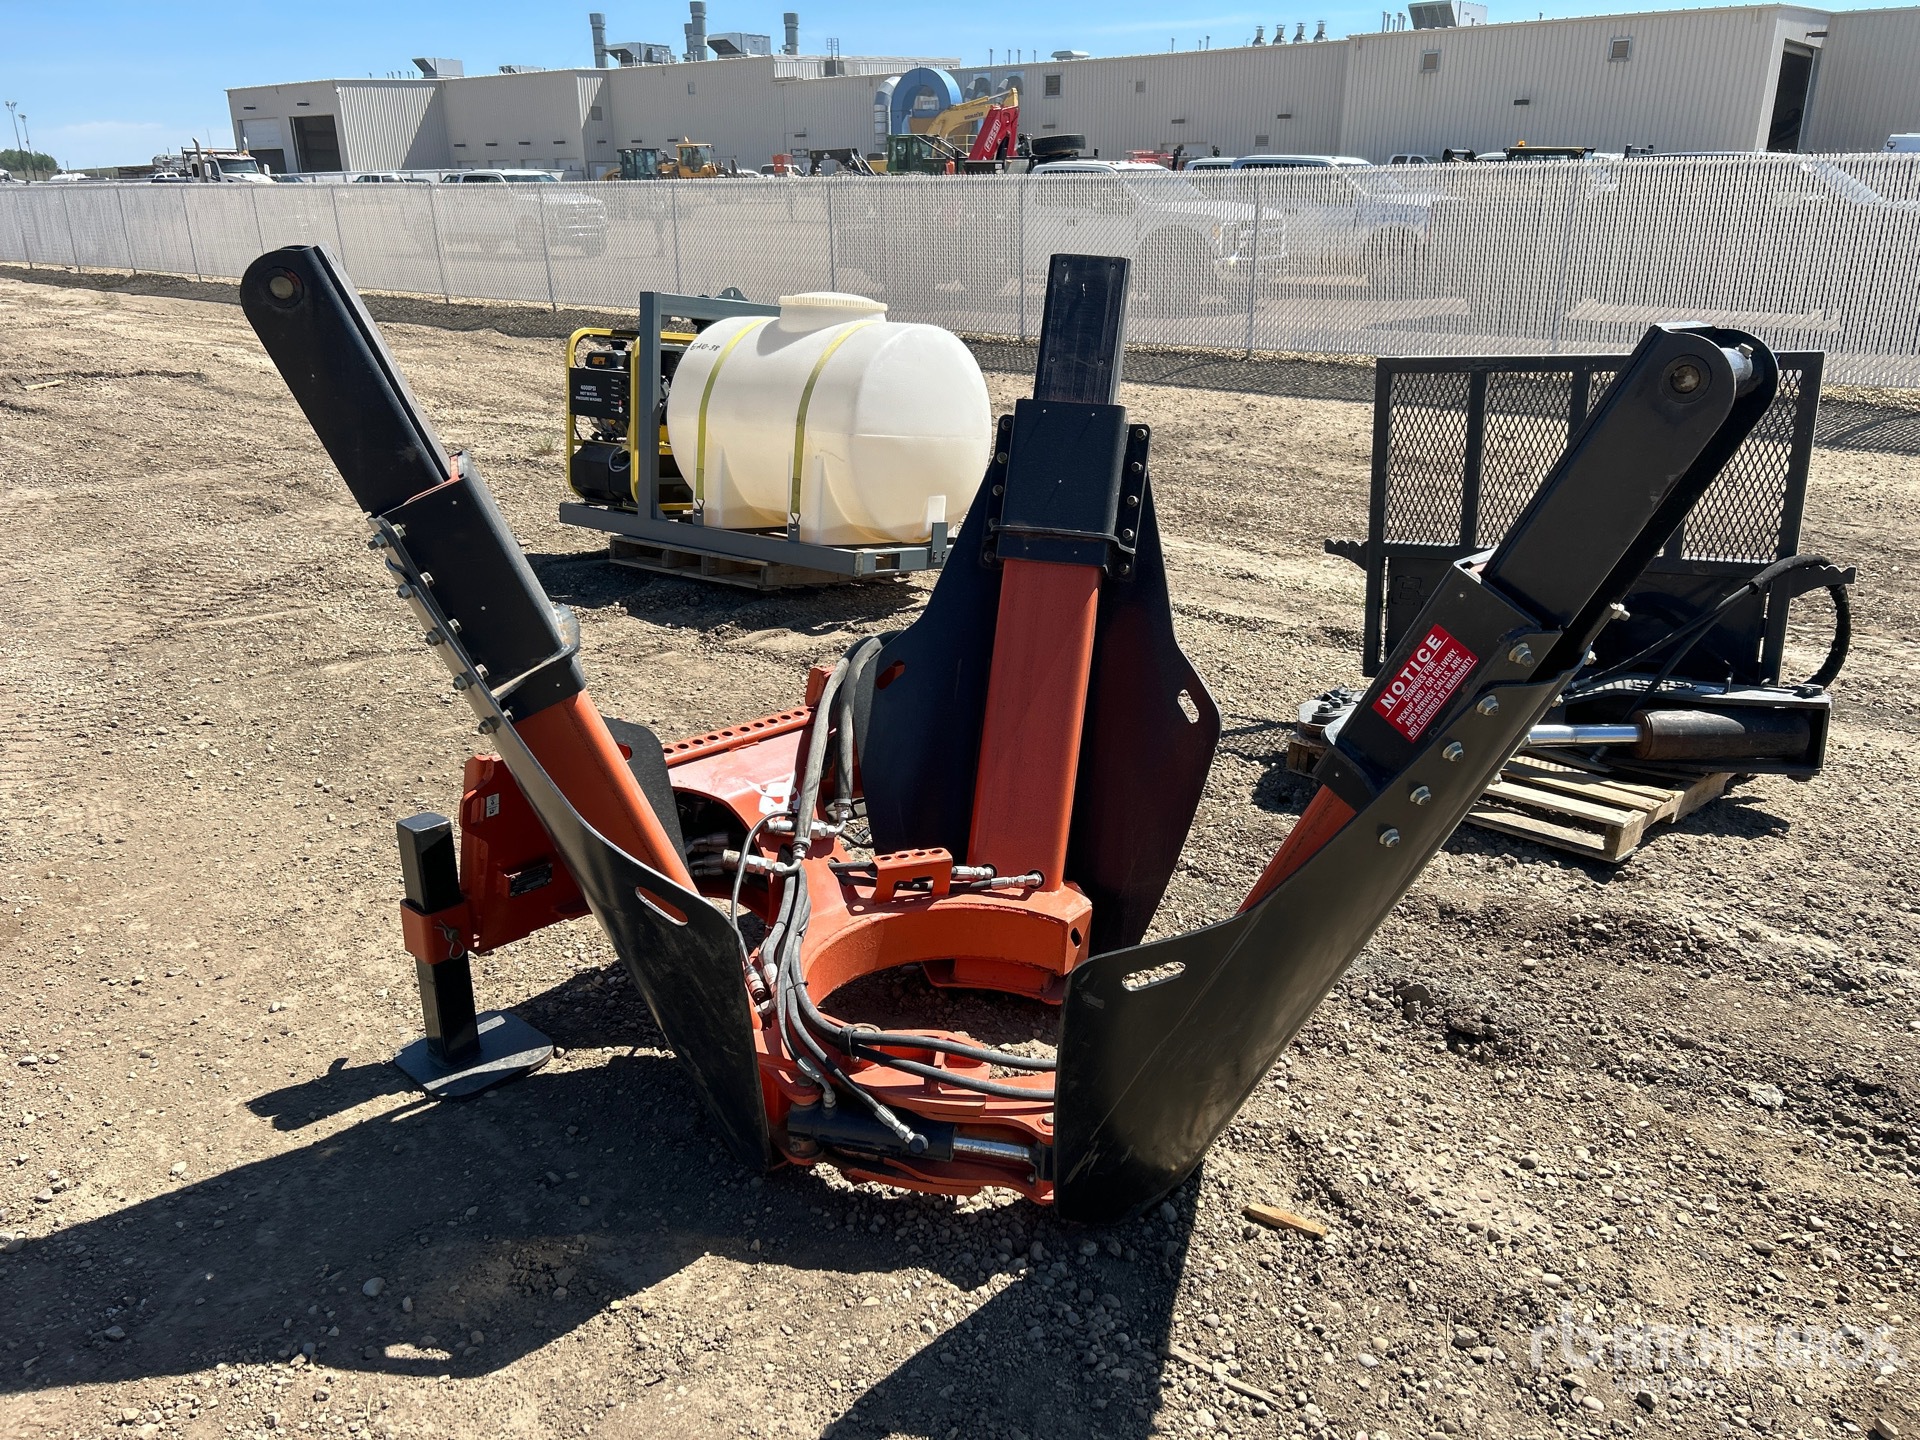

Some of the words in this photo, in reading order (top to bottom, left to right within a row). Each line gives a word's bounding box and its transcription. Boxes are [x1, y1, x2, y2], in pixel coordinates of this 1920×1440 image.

[1380, 634, 1443, 710] NOTICE
[1396, 702, 1416, 725] PICKUP
[1412, 689, 1425, 705] AND
[1425, 677, 1436, 688] OR
[1402, 674, 1427, 702] CHARGES
[1424, 660, 1438, 676] FOR:
[1405, 714, 1417, 727] AND
[1414, 689, 1436, 714] SERVICE
[1450, 655, 1463, 670] ARE
[1407, 724, 1420, 738] NOT
[1417, 698, 1440, 725] COVERED
[1437, 689, 1447, 699] BY
[1444, 656, 1474, 690] WARRANTY
